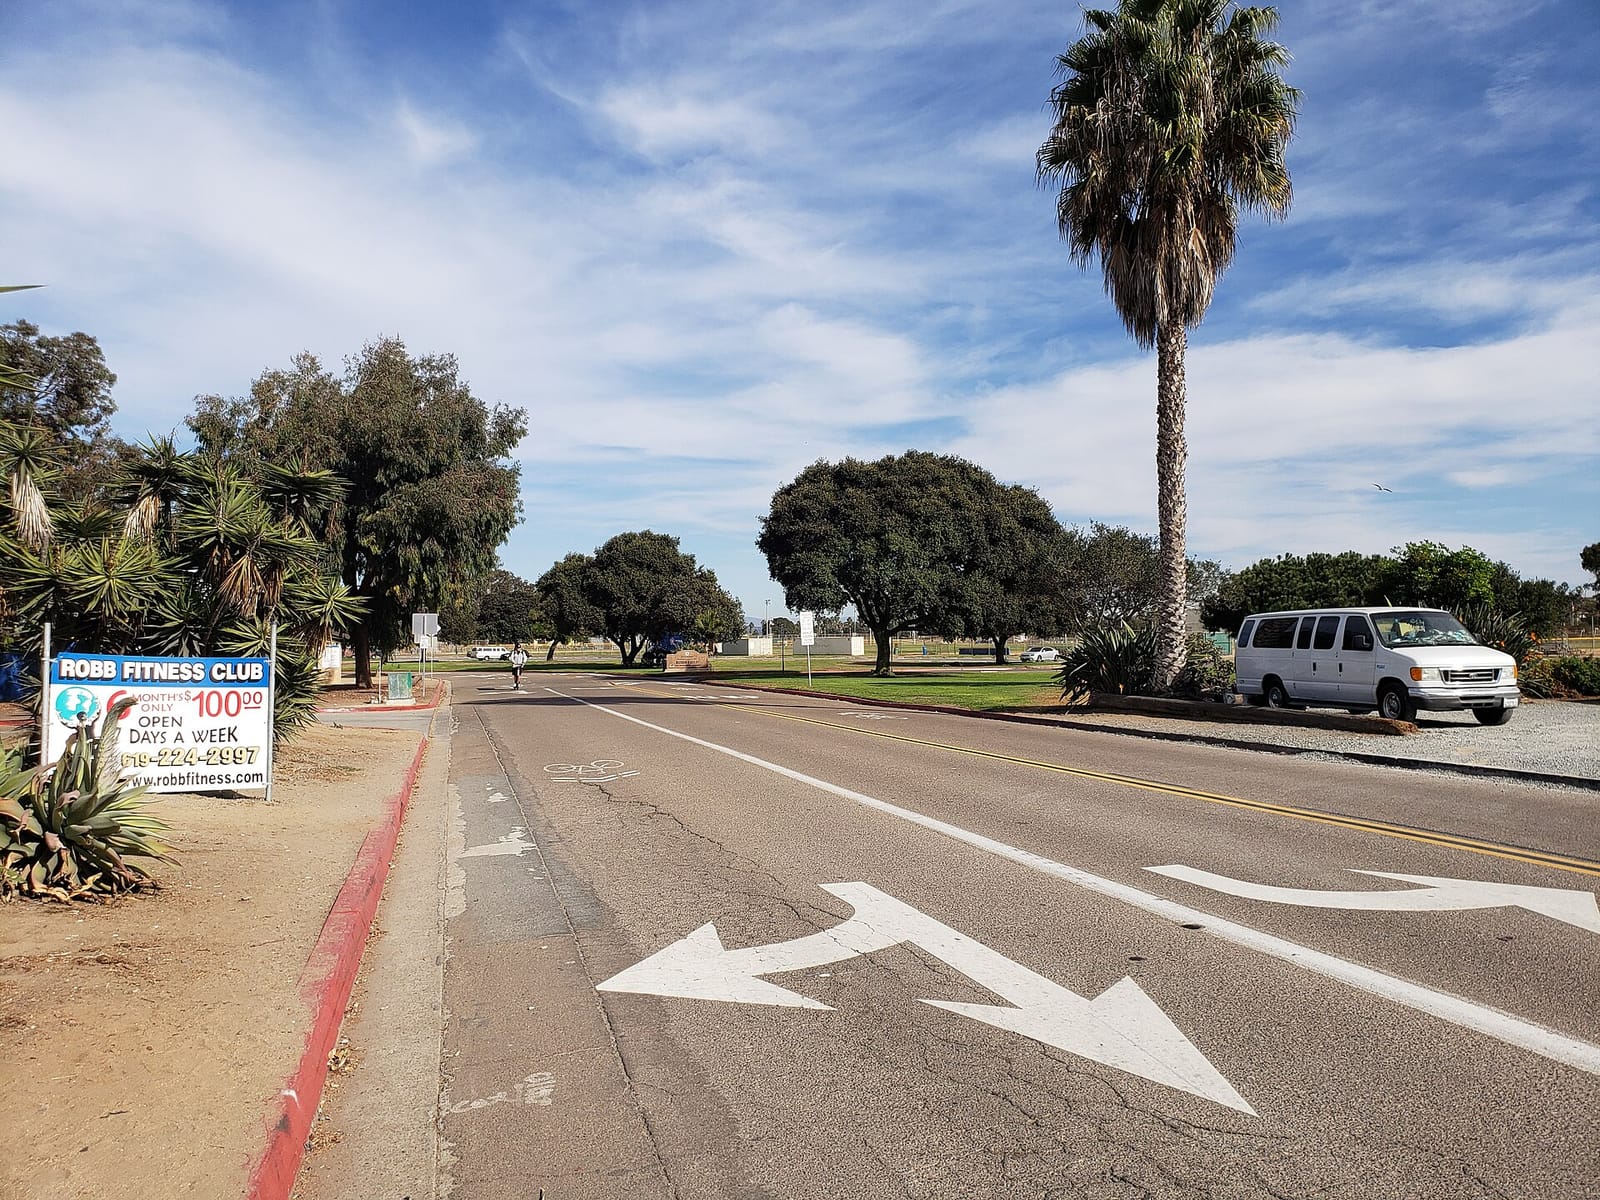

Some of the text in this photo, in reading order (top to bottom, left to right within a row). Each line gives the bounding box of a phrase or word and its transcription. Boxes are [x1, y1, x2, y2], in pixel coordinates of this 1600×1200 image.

[59, 658, 264, 683] ROBB FITNESS CLUB
[140, 703, 173, 712] ONLY
[138, 716, 183, 728] OPEN
[129, 729, 167, 744] DAYS
[173, 731, 185, 744] A
[191, 725, 239, 743] WEEK
[121, 746, 261, 767] 619-224-2997
[126, 771, 264, 787] ww.robbfitness.com
